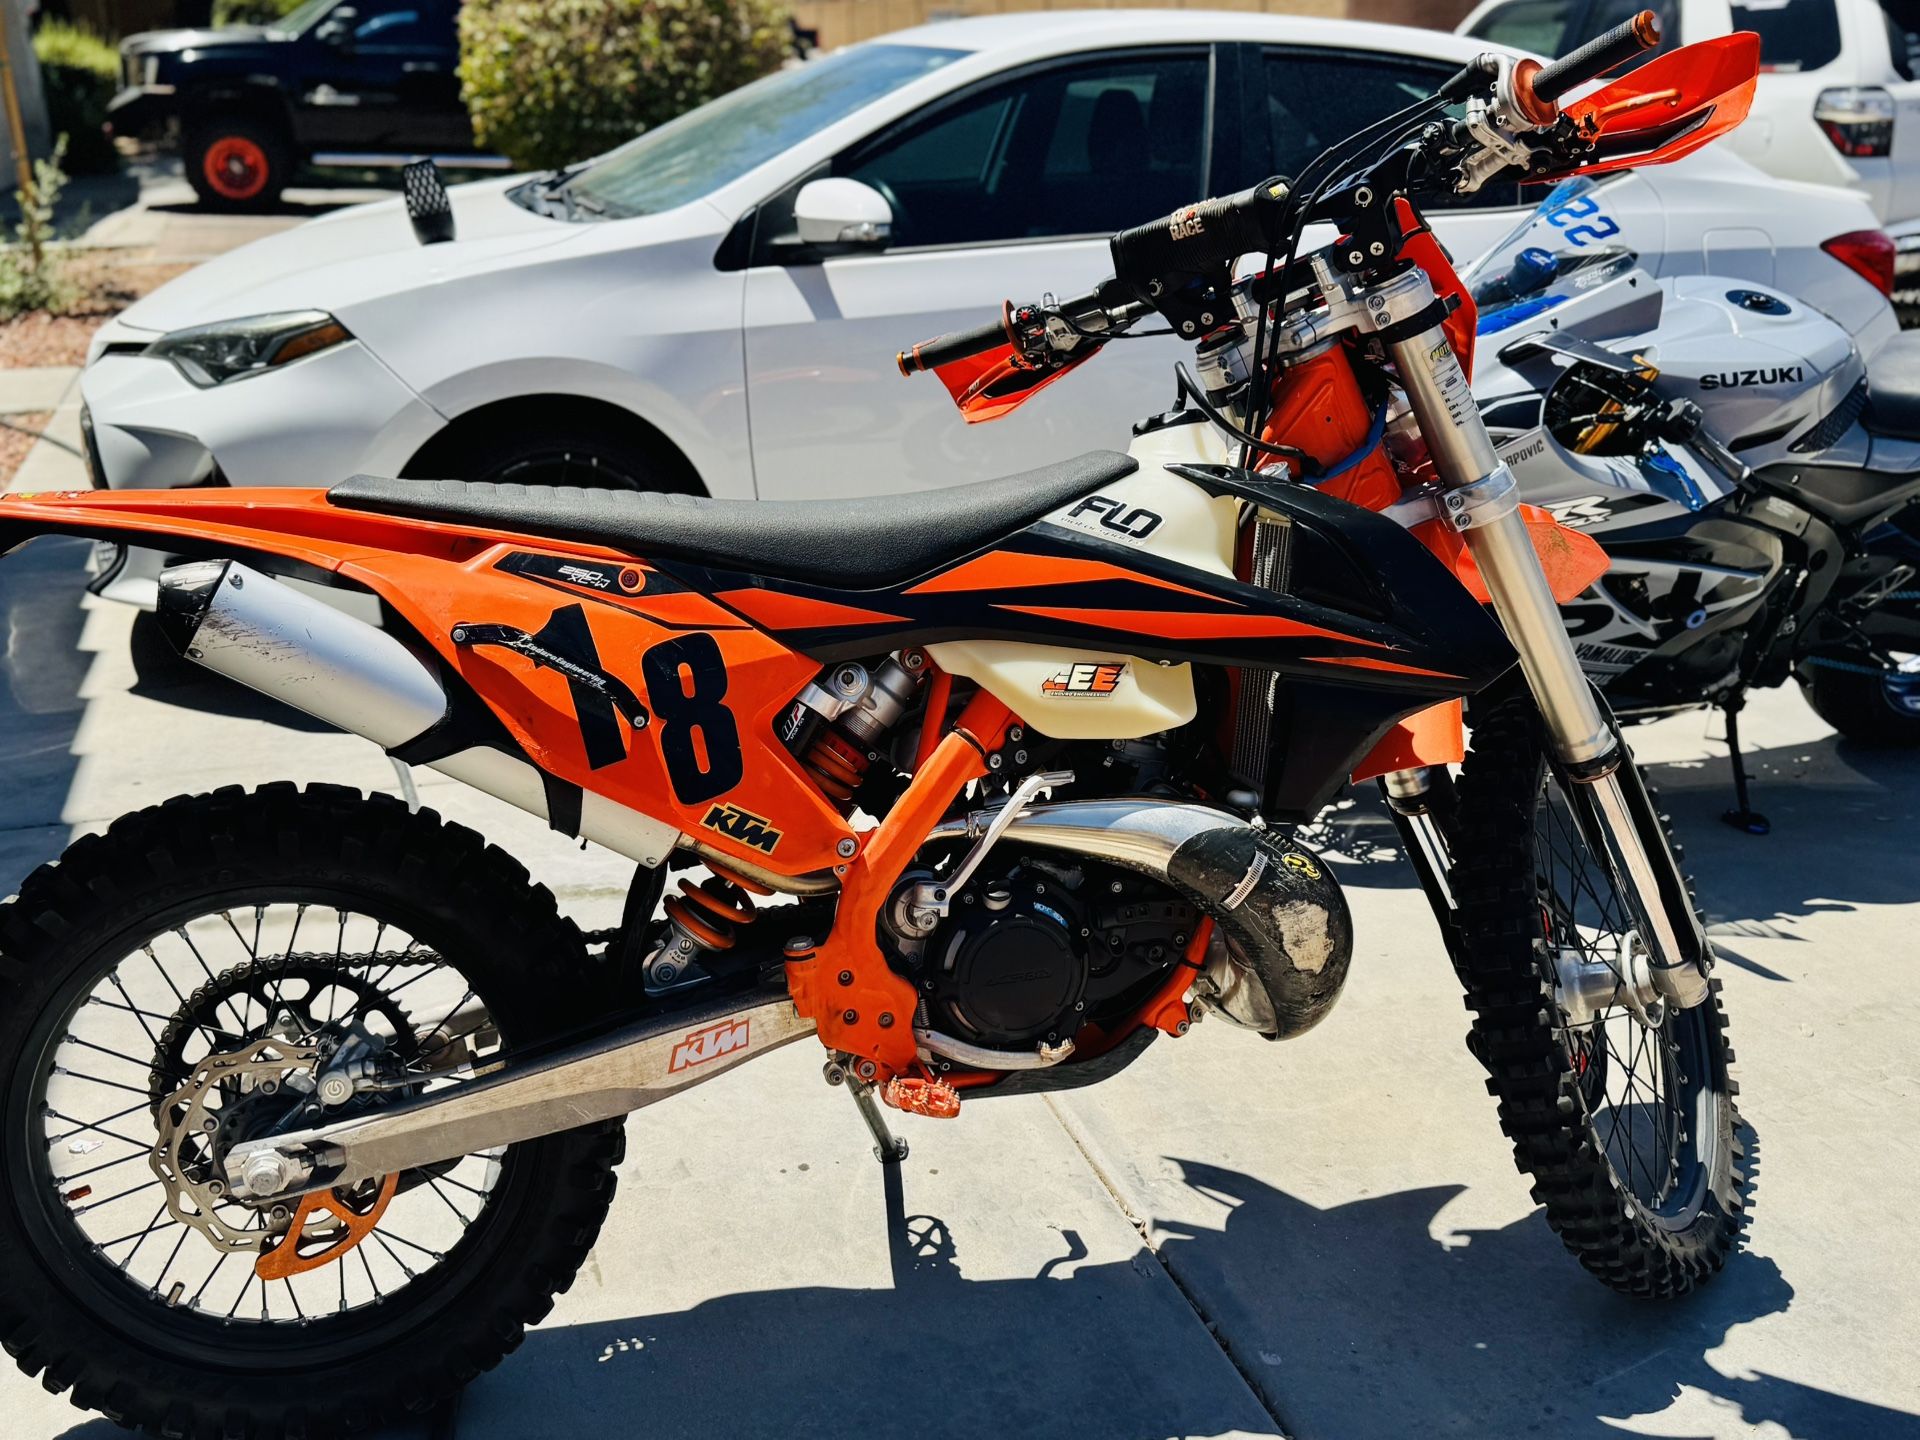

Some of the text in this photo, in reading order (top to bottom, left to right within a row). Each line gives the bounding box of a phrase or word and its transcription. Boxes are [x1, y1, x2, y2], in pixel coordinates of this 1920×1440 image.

[1168, 217, 1204, 240] RACE
[1699, 366, 1804, 390] SUZUKI
[1067, 495, 1163, 539] FLO
[558, 565, 603, 580] 250
[533, 603, 743, 806] 18
[701, 803, 783, 854] KTM
[669, 1019, 749, 1073] KTM
